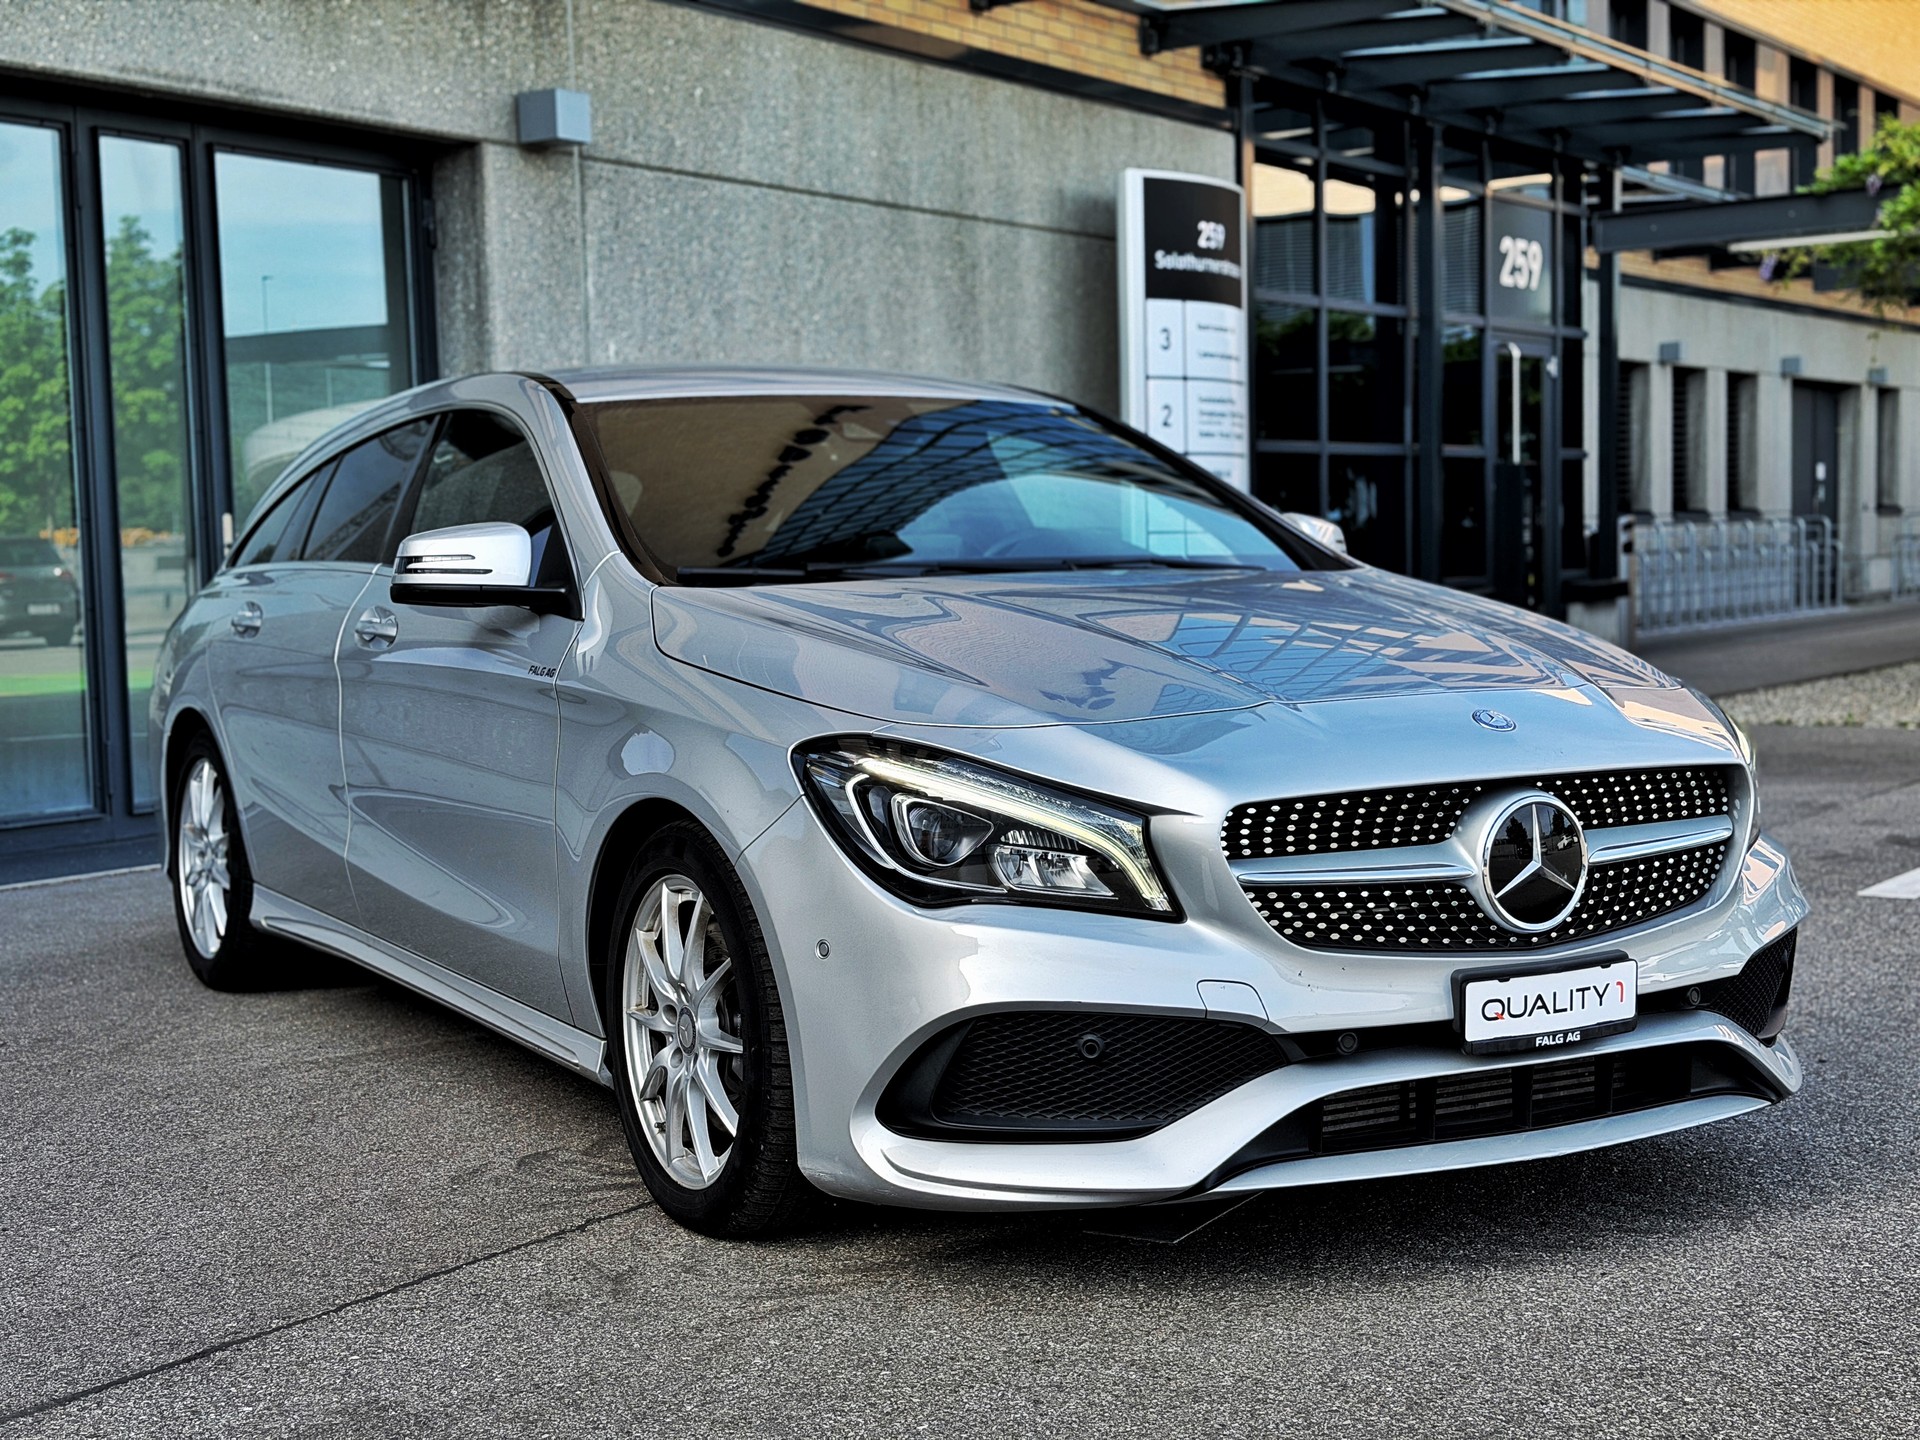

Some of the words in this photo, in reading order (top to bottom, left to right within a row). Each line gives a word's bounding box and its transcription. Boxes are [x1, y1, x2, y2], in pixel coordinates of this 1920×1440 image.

[1197, 220, 1226, 250] 259
[1499, 235, 1543, 291] 259
[1160, 327, 1171, 350] 3
[1161, 404, 1172, 427] 2
[528, 665, 546, 677] FALG
[545, 668, 556, 678] AG
[1481, 982, 1611, 1022] QUALITY
[1616, 980, 1625, 1003] 1
[1535, 1033, 1564, 1047] FALG
[1565, 1031, 1581, 1043] AG
